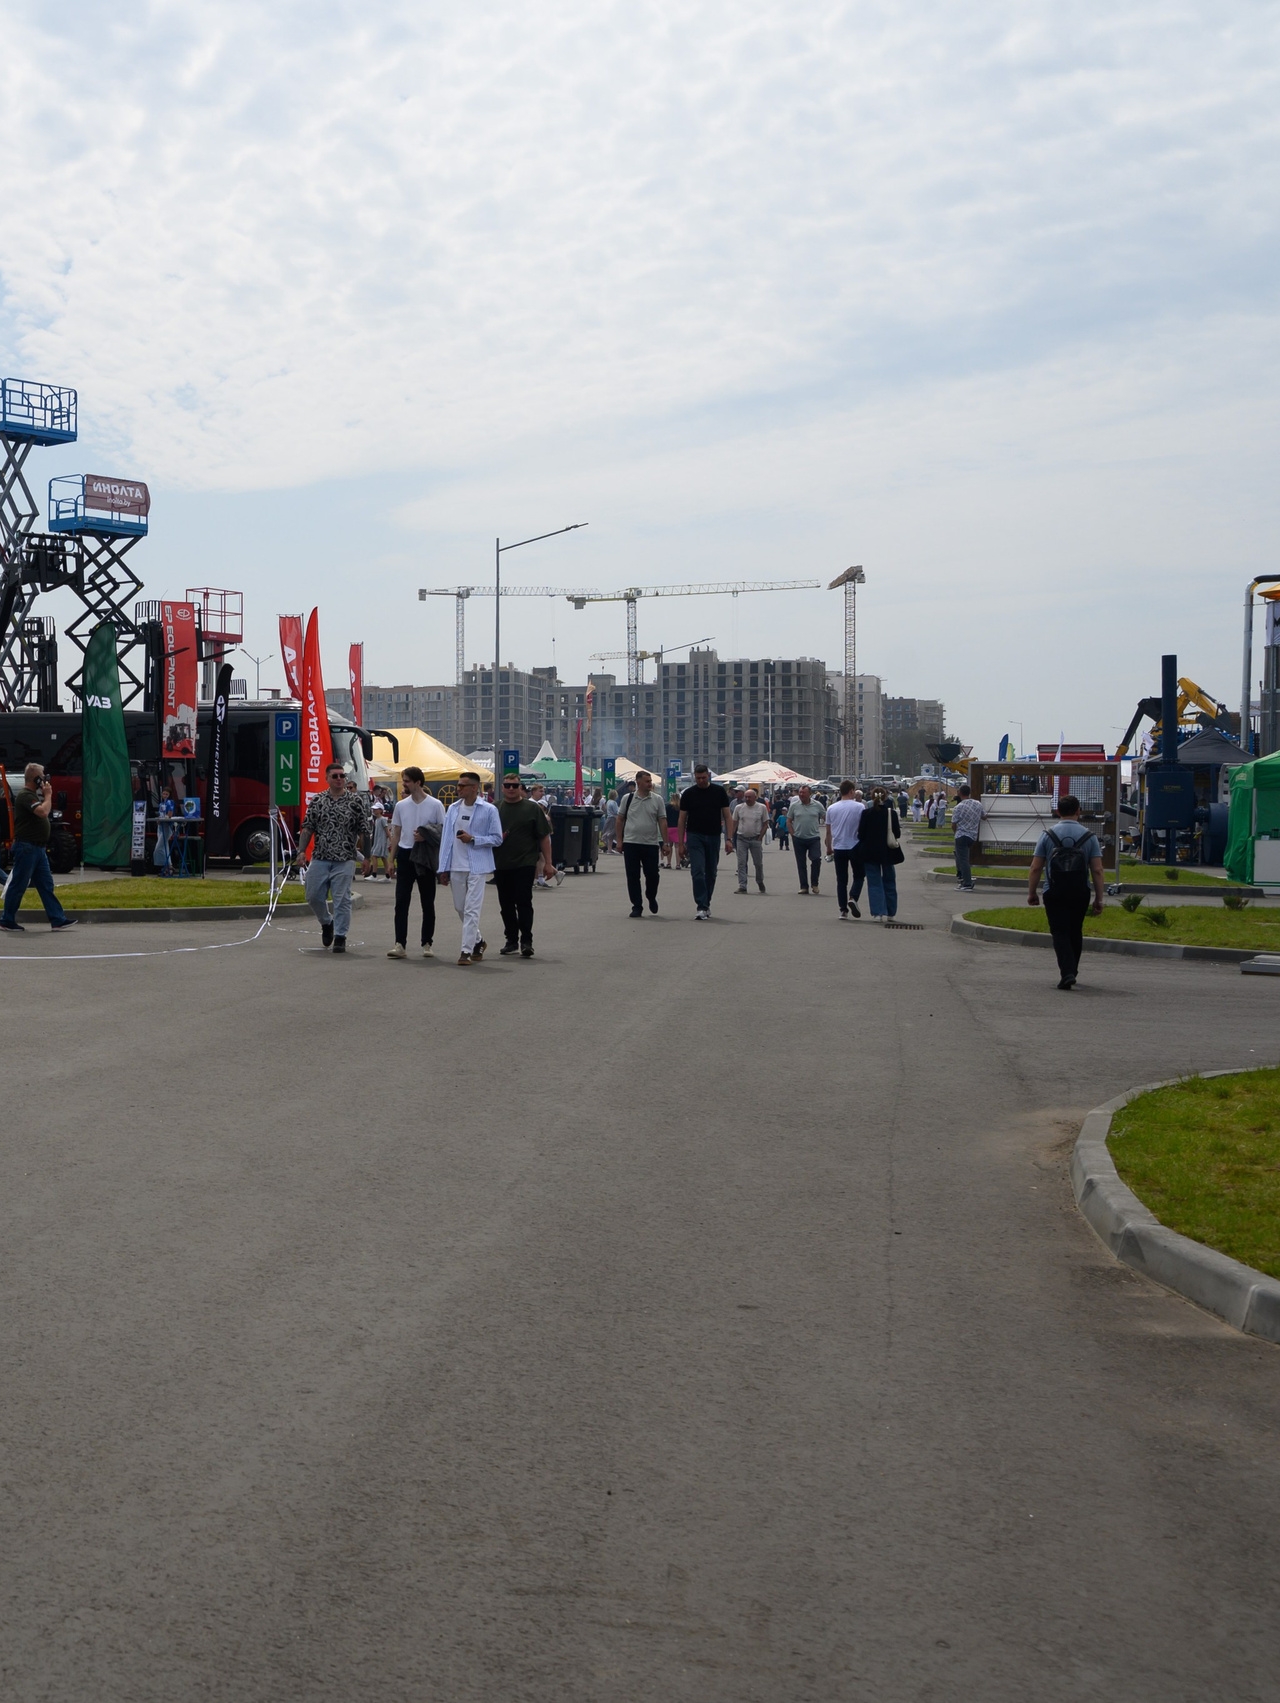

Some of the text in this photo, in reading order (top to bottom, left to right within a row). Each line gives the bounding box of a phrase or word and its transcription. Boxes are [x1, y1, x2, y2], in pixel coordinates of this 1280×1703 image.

[166, 625, 176, 709] EQUPMENT
[86, 694, 112, 709] УАЗ
[282, 720, 292, 734] P
[280, 753, 293, 770] N
[281, 777, 292, 793] 5
